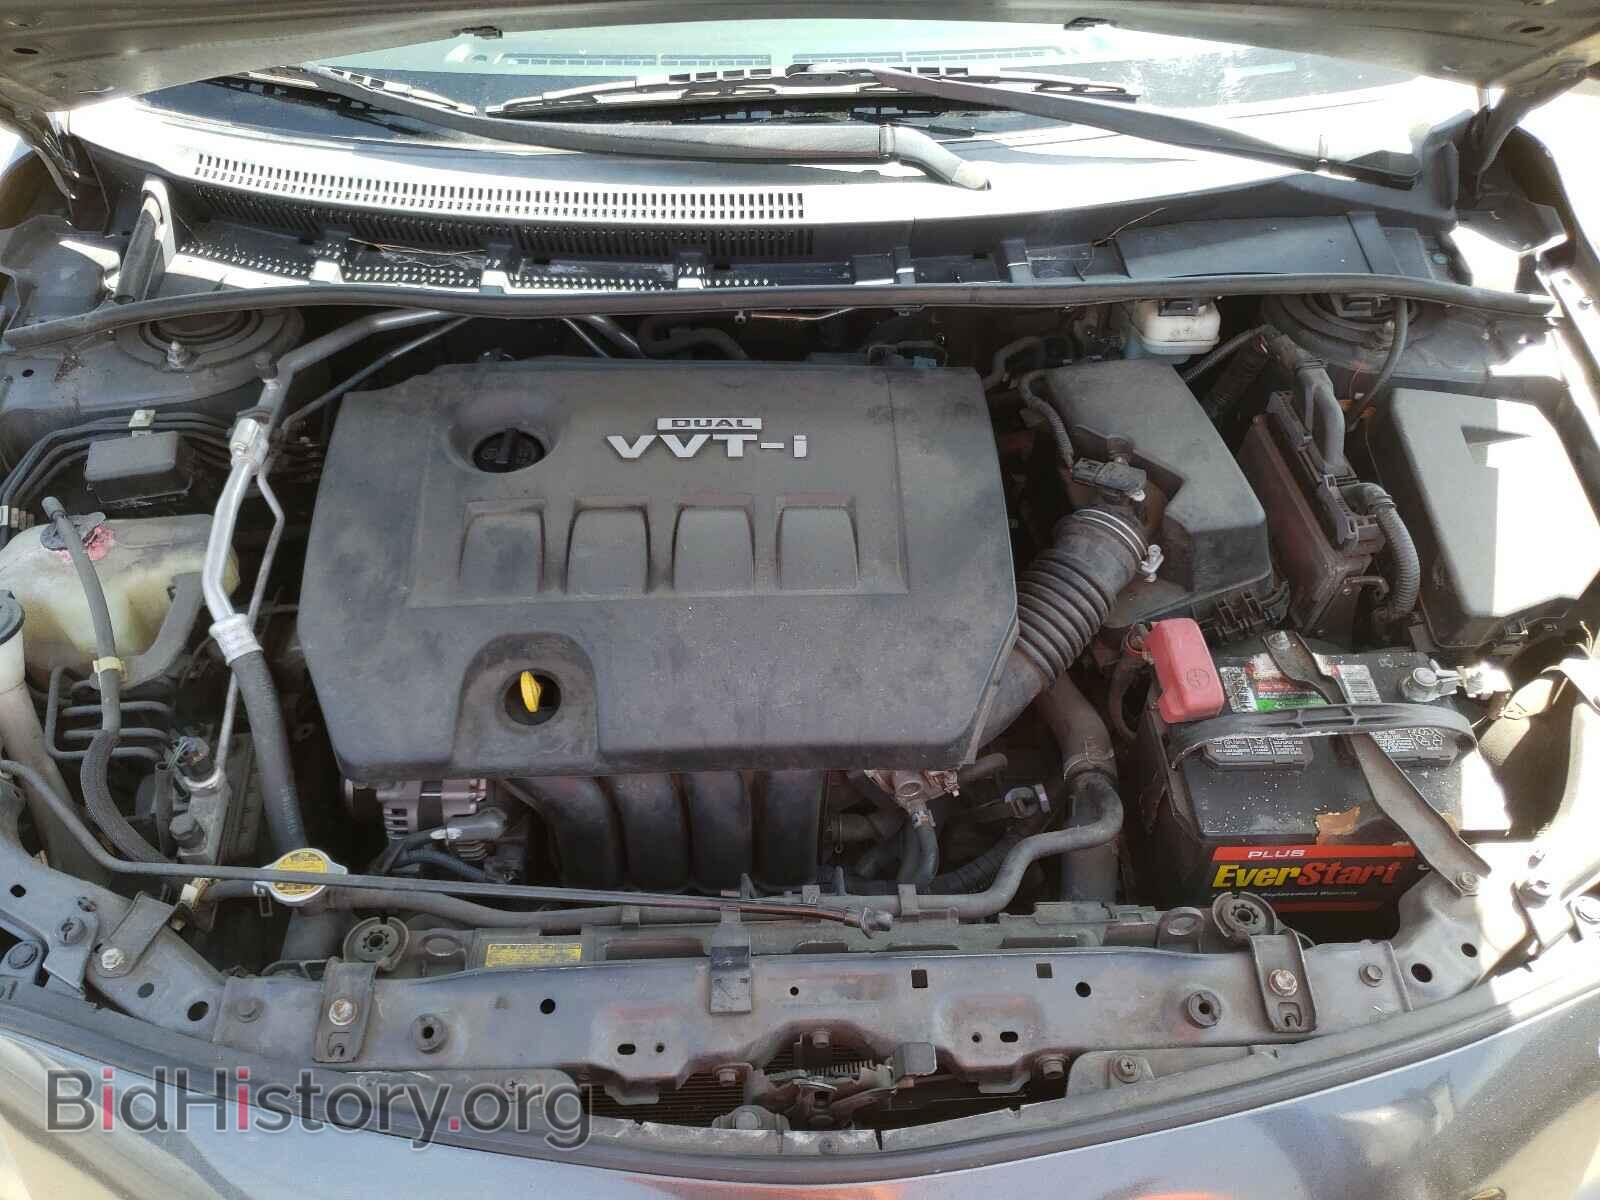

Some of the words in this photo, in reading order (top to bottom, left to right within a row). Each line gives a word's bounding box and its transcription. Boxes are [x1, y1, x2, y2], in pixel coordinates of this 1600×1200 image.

[671, 419, 753, 428] DUAL
[606, 433, 808, 459] VVT-i
[1247, 849, 1305, 858] PLUS
[1212, 862, 1401, 888] EverStart
